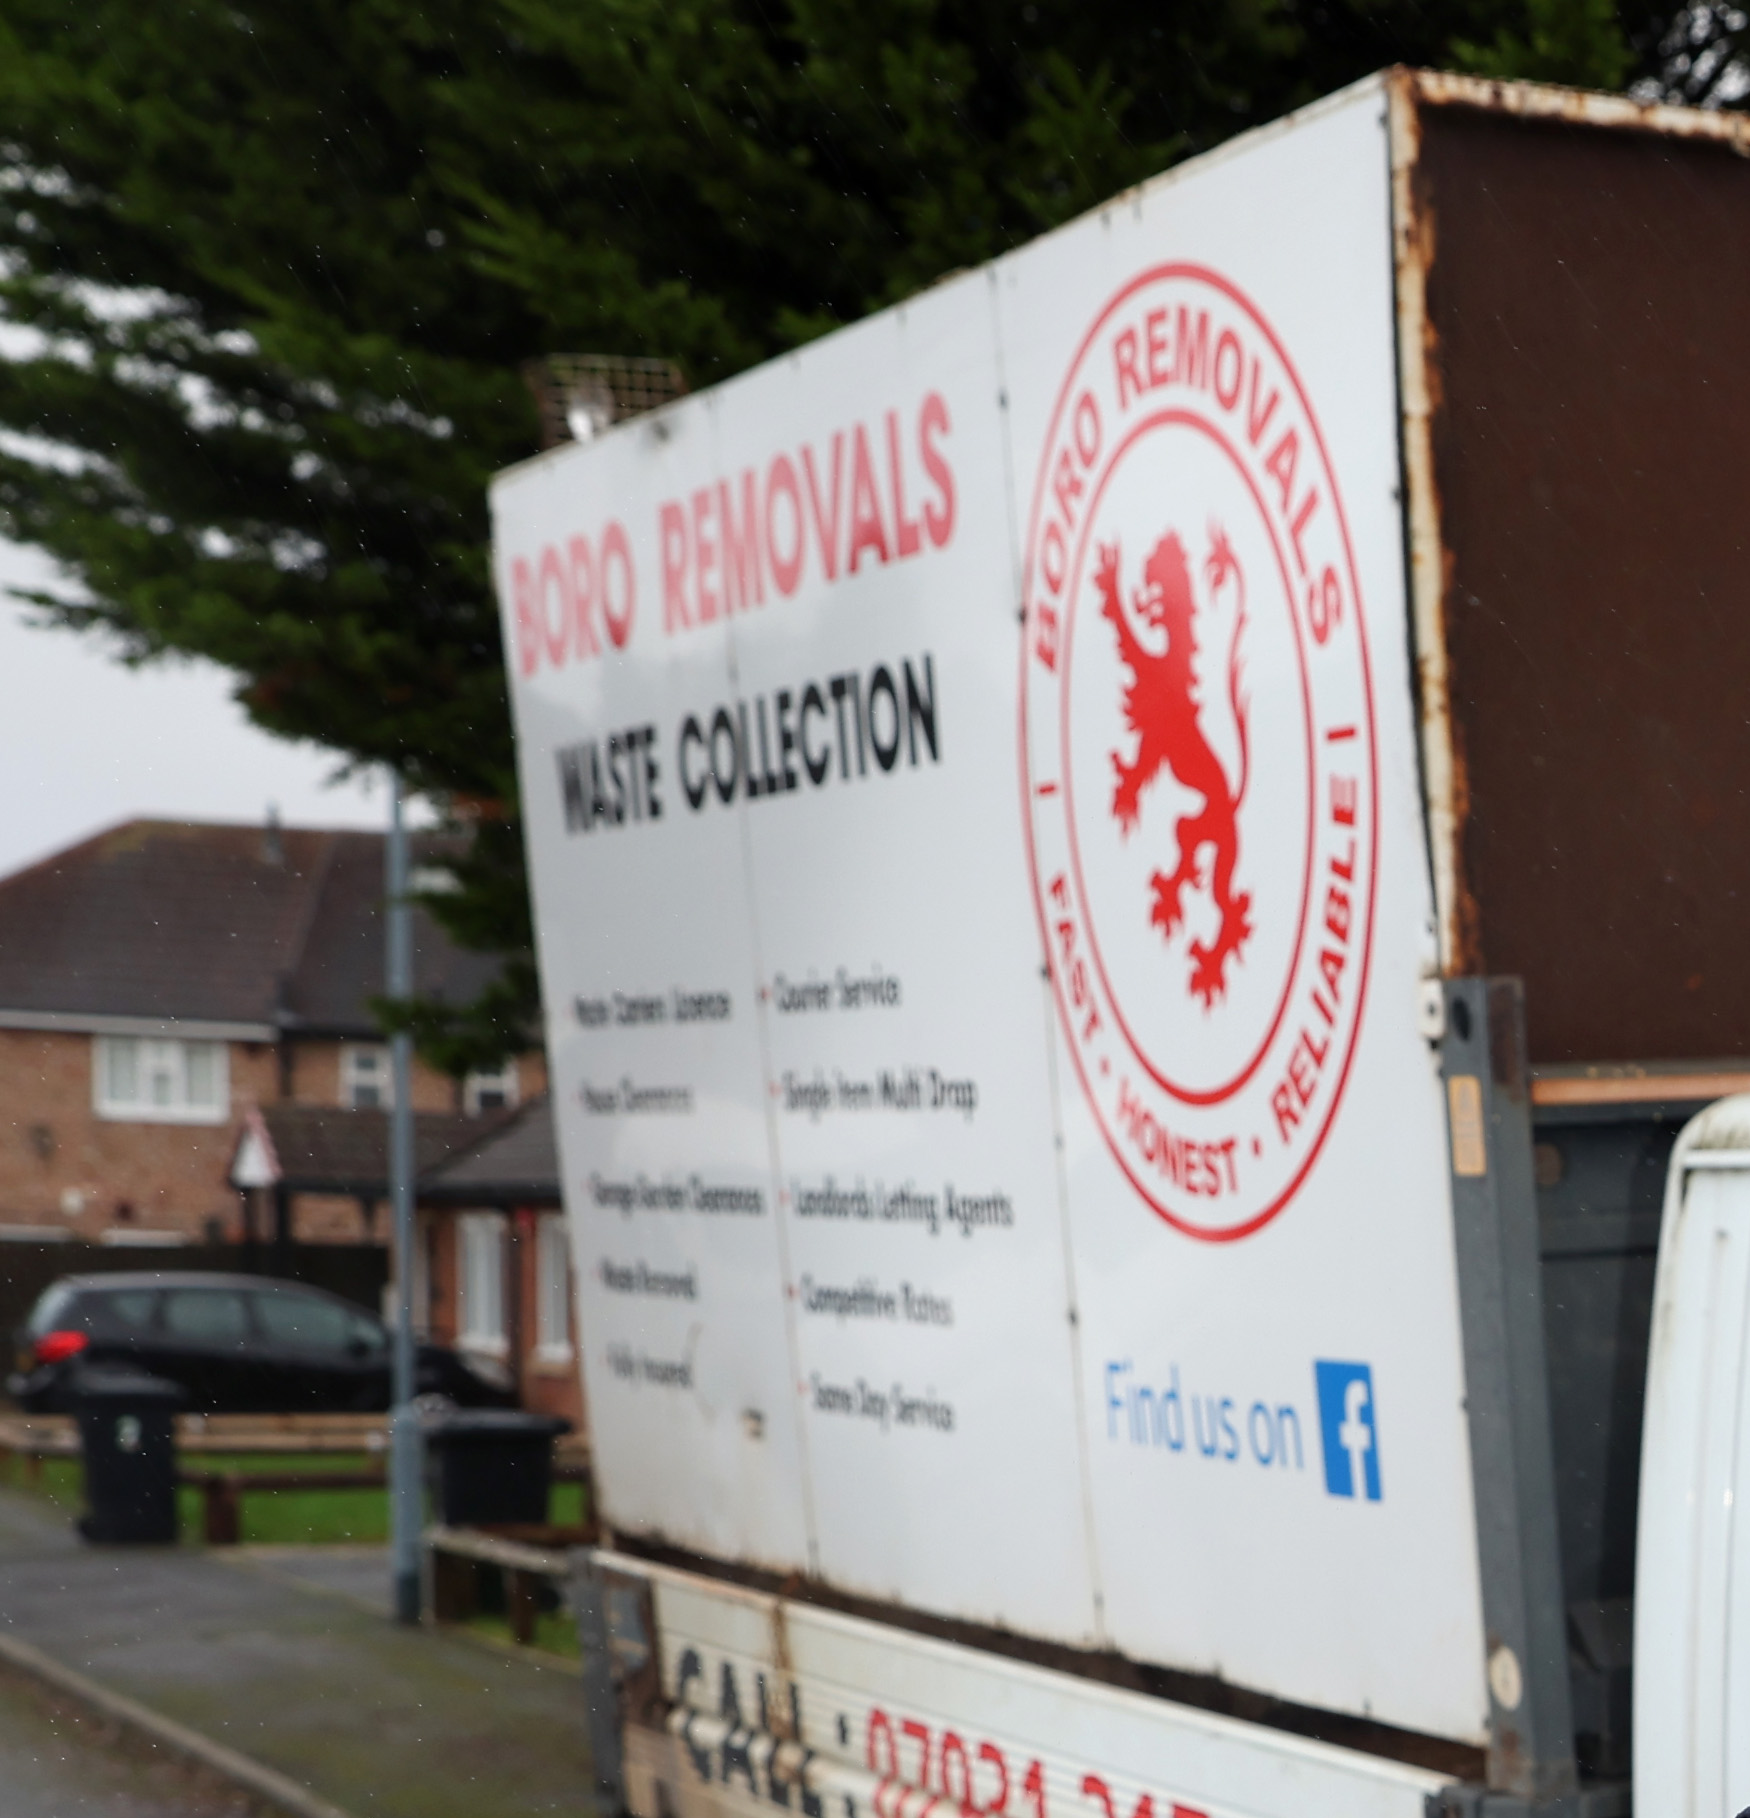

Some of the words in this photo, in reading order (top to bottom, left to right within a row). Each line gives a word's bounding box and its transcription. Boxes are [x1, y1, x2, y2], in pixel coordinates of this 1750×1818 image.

[508, 519, 636, 680] BORO
[657, 391, 958, 637] REMOVALS
[1036, 391, 1102, 674] BORO
[1112, 305, 1345, 648] REMOVALS
[554, 722, 665, 837] WASTE
[677, 653, 940, 816] COLLECTION
[835, 961, 901, 1010] Service
[1049, 872, 1102, 1042] FAST
[1116, 1077, 1239, 1199] HONEST
[1270, 774, 1358, 1144] RELIABLE
[876, 1066, 922, 1111] Multi
[926, 1065, 978, 1123] Drop
[945, 1180, 1014, 1238] Agents
[1105, 1357, 1185, 1453] Find
[1191, 1393, 1241, 1462] us
[1248, 1400, 1304, 1471] on
